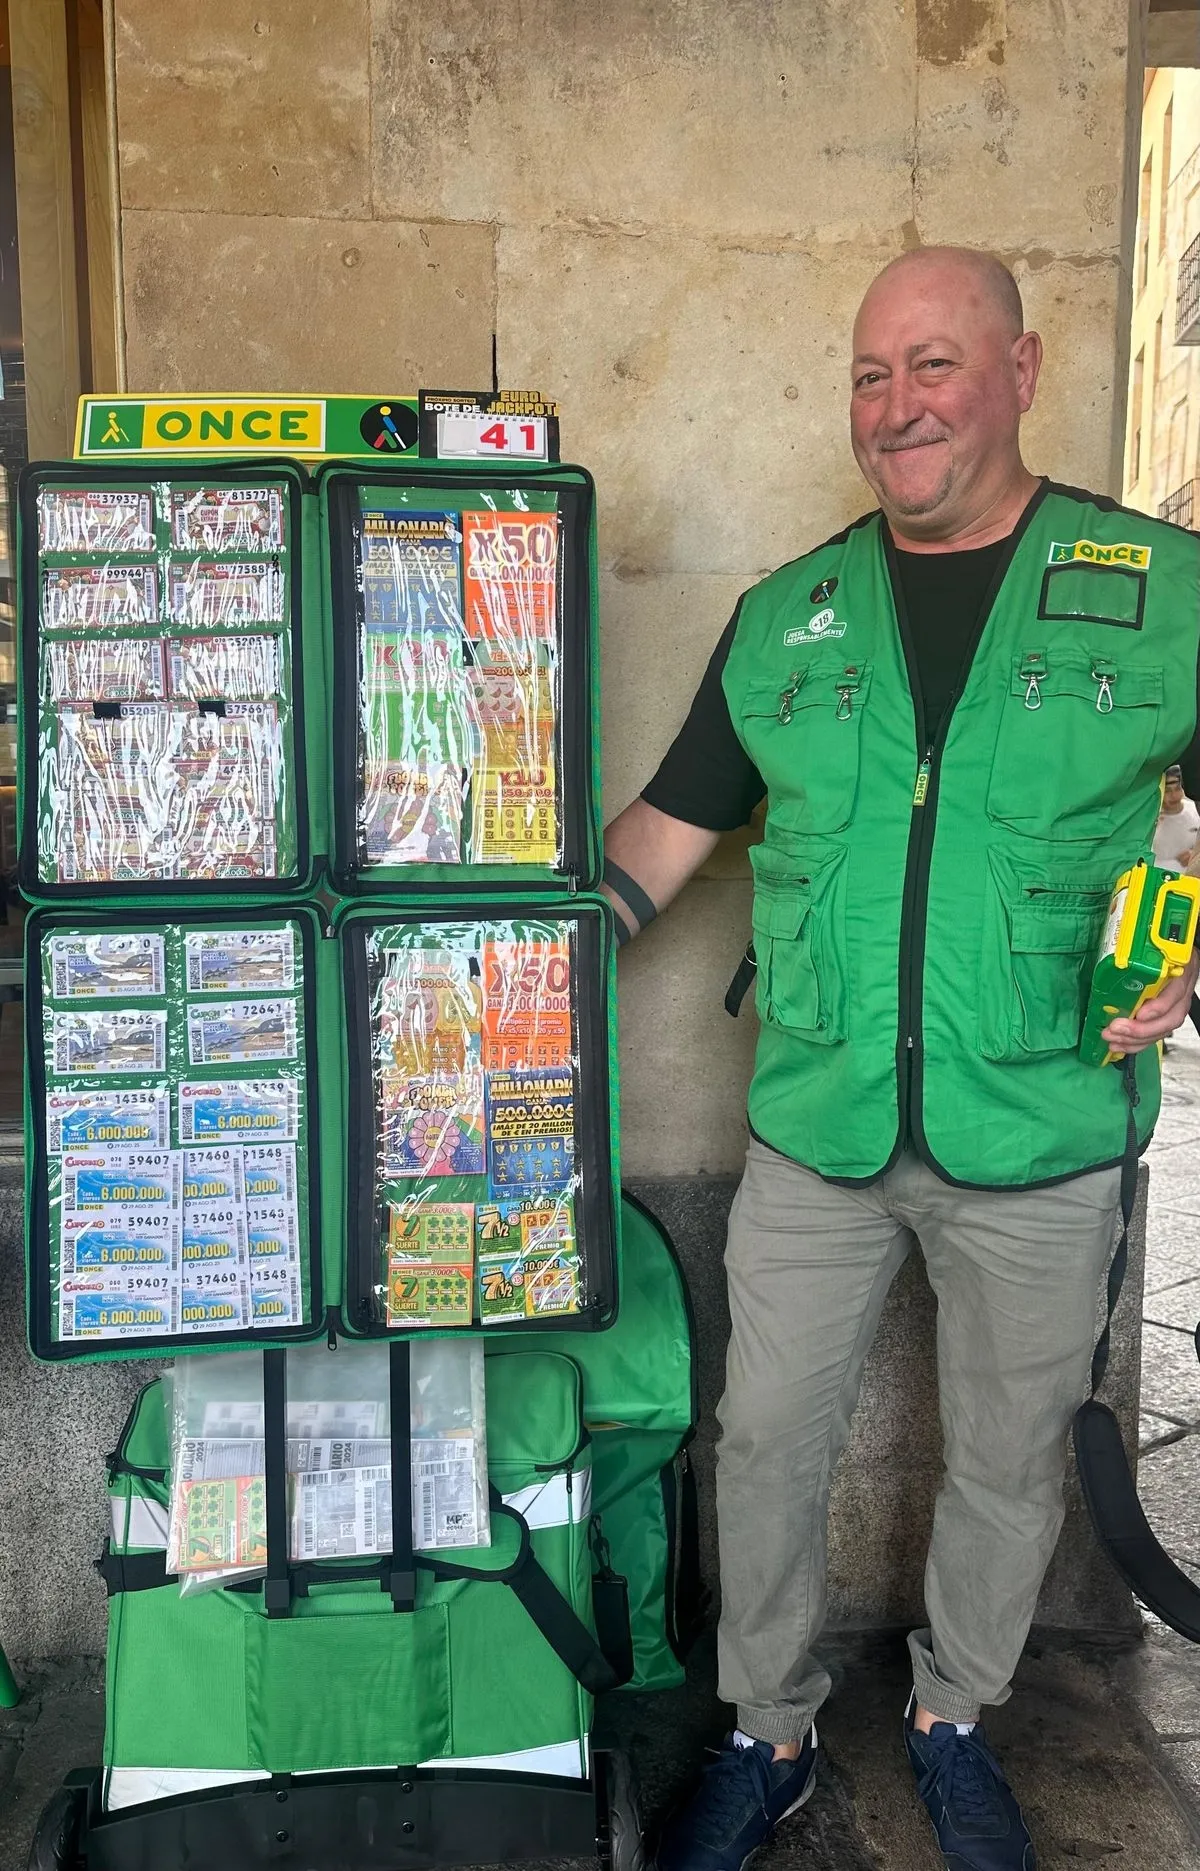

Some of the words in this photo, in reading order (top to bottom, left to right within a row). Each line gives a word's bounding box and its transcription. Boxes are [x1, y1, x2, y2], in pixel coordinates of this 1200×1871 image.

[500, 390, 540, 402] EURO
[424, 402, 460, 413] BOTE
[462, 405, 481, 413] DE
[487, 401, 555, 416] JACKPOT
[156, 410, 308, 441] ONCE
[480, 423, 535, 451] 41
[231, 490, 266, 501] 81577
[363, 519, 456, 540] MILLONARIO
[1079, 544, 1144, 564] ONCE
[106, 568, 142, 579] 99944
[813, 613, 829, 628] +18
[786, 628, 843, 644] RESPONSABLEMENTE
[787, 629, 805, 639] JUEGA
[121, 706, 157, 716] 05205
[226, 704, 262, 714] 57566
[915, 775, 927, 802] ONCE
[242, 1003, 282, 1016] 72641
[487, 998, 505, 1009] GAN
[111, 1014, 153, 1025] 34562
[115, 1093, 155, 1105] 14356
[533, 1126, 573, 1135] PREMIOS!
[128, 1155, 170, 1166] 59407
[189, 1150, 230, 1163] 37460
[128, 1216, 169, 1227] 59407
[192, 1211, 233, 1224] 37460
[395, 1240, 419, 1250] SUERTE
[127, 1278, 169, 1289] 59407
[196, 1272, 237, 1286] 37460
[399, 1277, 418, 1298] 7
[394, 1302, 418, 1311] SUERTE
[195, 1441, 205, 1461] 2024
[343, 1442, 352, 1463] 2024
